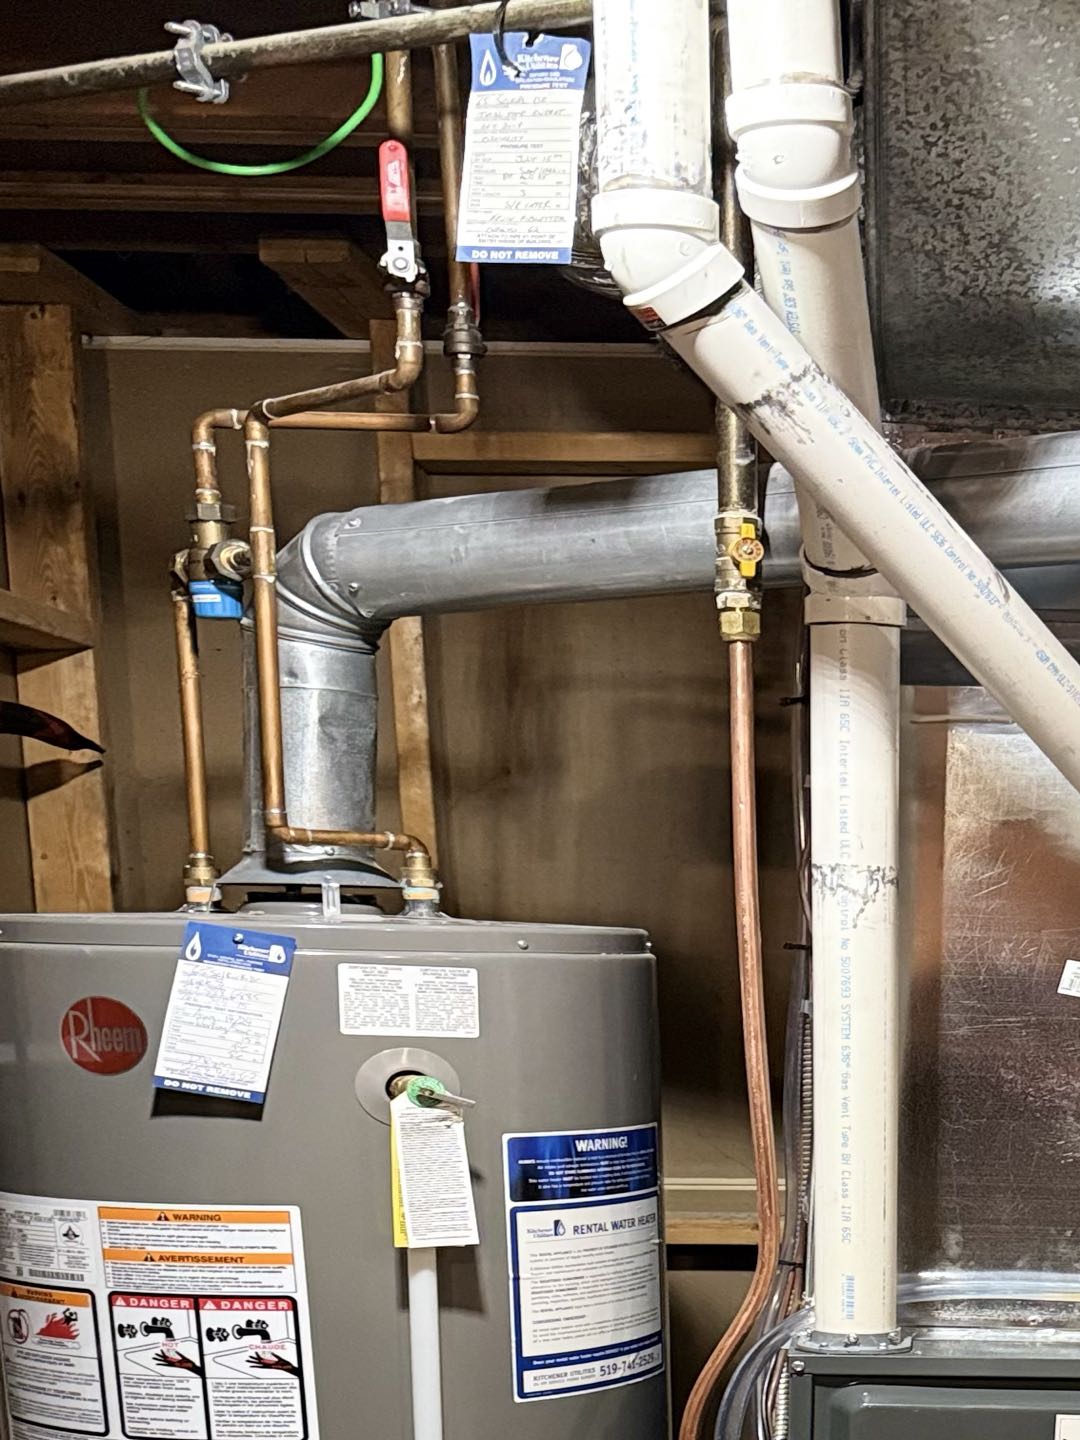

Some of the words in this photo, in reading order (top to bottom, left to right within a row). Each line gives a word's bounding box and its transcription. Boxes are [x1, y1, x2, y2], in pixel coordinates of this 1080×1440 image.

[472, 250, 488, 259] DO
[490, 250, 513, 259] NOT
[515, 251, 559, 260] REMOVE
[839, 713, 851, 733] 65C
[839, 739, 851, 788] Intertek
[839, 794, 851, 833] Listed
[839, 938, 851, 950] No
[839, 956, 851, 999] 5007693
[68, 998, 143, 1063] Rheem
[839, 1003, 851, 1040] SYSTEM
[163, 1079, 180, 1088] DO
[181, 1081, 206, 1092] NOT
[206, 1084, 251, 1099] REMOVE
[839, 1096, 851, 1119] Vent
[575, 1136, 629, 1152] WARNING!
[839, 1125, 851, 1149] Type
[839, 1170, 851, 1199] Class
[172, 1213, 222, 1222] WARNING
[573, 1222, 609, 1235] RENTAL
[611, 1217, 636, 1230] WATER
[637, 1213, 656, 1226] HEATER
[839, 1226, 851, 1245] 65C
[158, 1254, 245, 1264] AVERTISSEMENT
[129, 1298, 190, 1309] DANGER
[220, 1300, 289, 1310] DANGER
